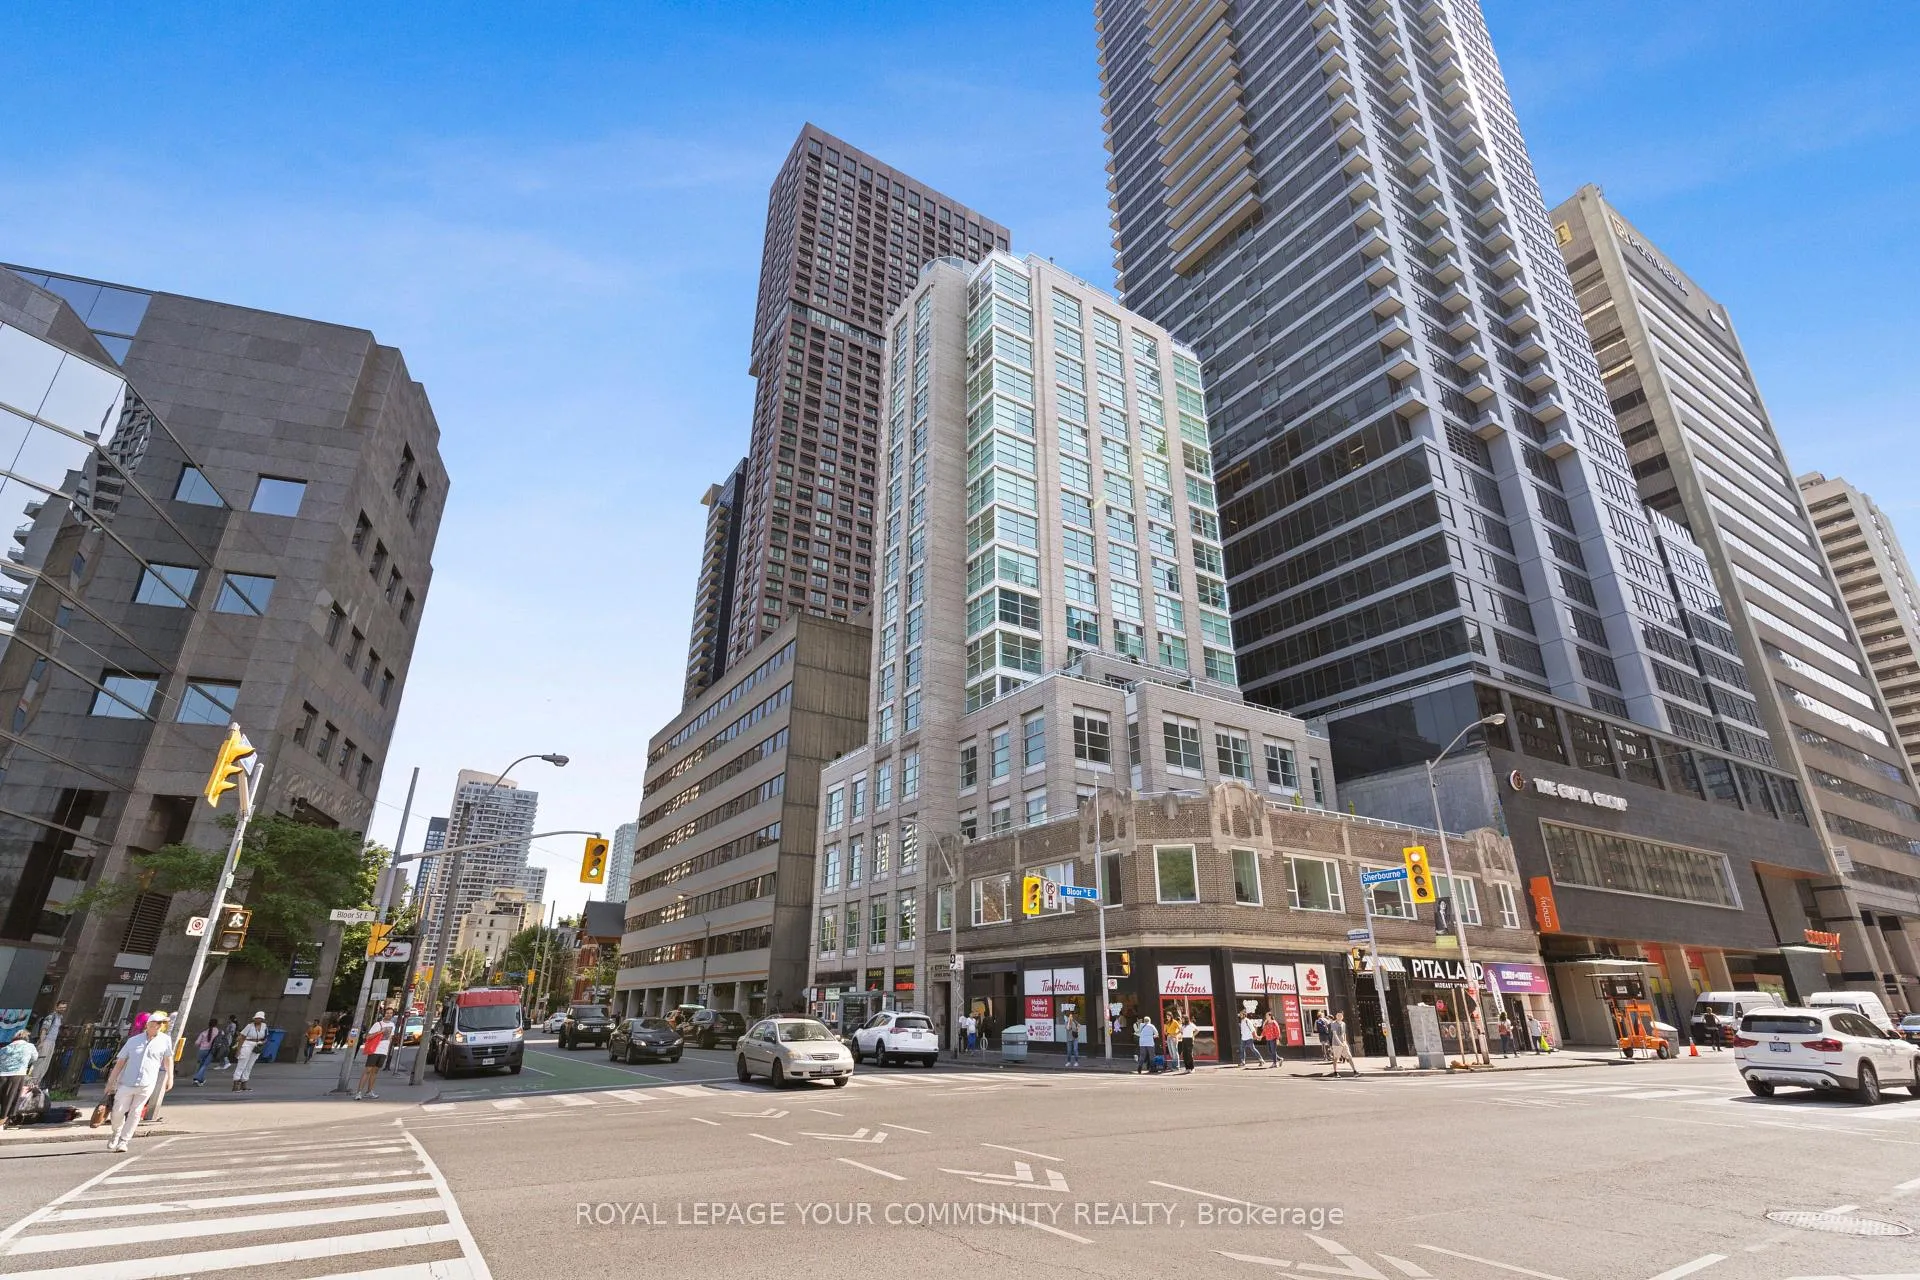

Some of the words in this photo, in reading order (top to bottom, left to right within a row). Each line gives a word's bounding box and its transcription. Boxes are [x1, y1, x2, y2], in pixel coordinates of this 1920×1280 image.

[1363, 871, 1401, 882] Sherbourne
[1066, 887, 1082, 896] Bloor
[1087, 889, 1092, 897] E
[336, 911, 354, 919] Bloor
[1173, 966, 1193, 980] Tim
[1411, 959, 1445, 979] PITA
[1041, 979, 1053, 992] Tim
[1053, 978, 1080, 992] Hortons
[1165, 979, 1206, 993] Hortons
[1249, 975, 1266, 990] Tim
[1266, 975, 1296, 991] Hortons
